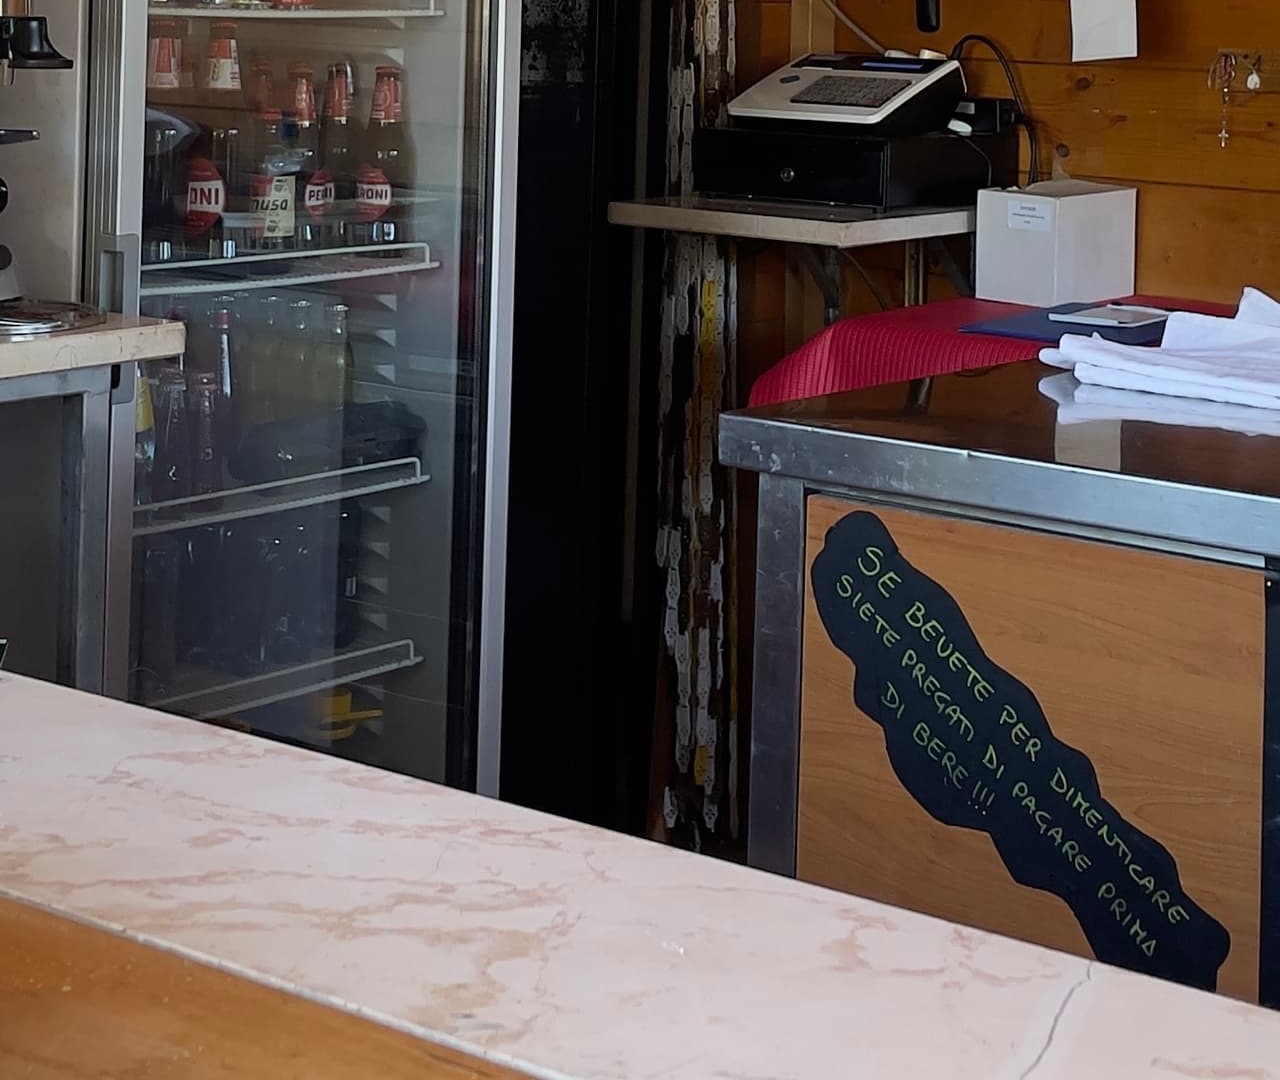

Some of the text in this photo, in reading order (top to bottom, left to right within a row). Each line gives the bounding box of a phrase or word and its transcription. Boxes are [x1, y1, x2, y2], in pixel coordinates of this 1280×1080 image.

[191, 187, 219, 205] ONI
[836, 573, 902, 649] SIETE
[983, 744, 1006, 780] DI
[1012, 780, 1094, 873] PAGARE
[1097, 882, 1158, 958] PRIMA
[858, 545, 1190, 925] SE BEVETE PER DIMENTICARE
[880, 681, 996, 817] DI BERE !!!
